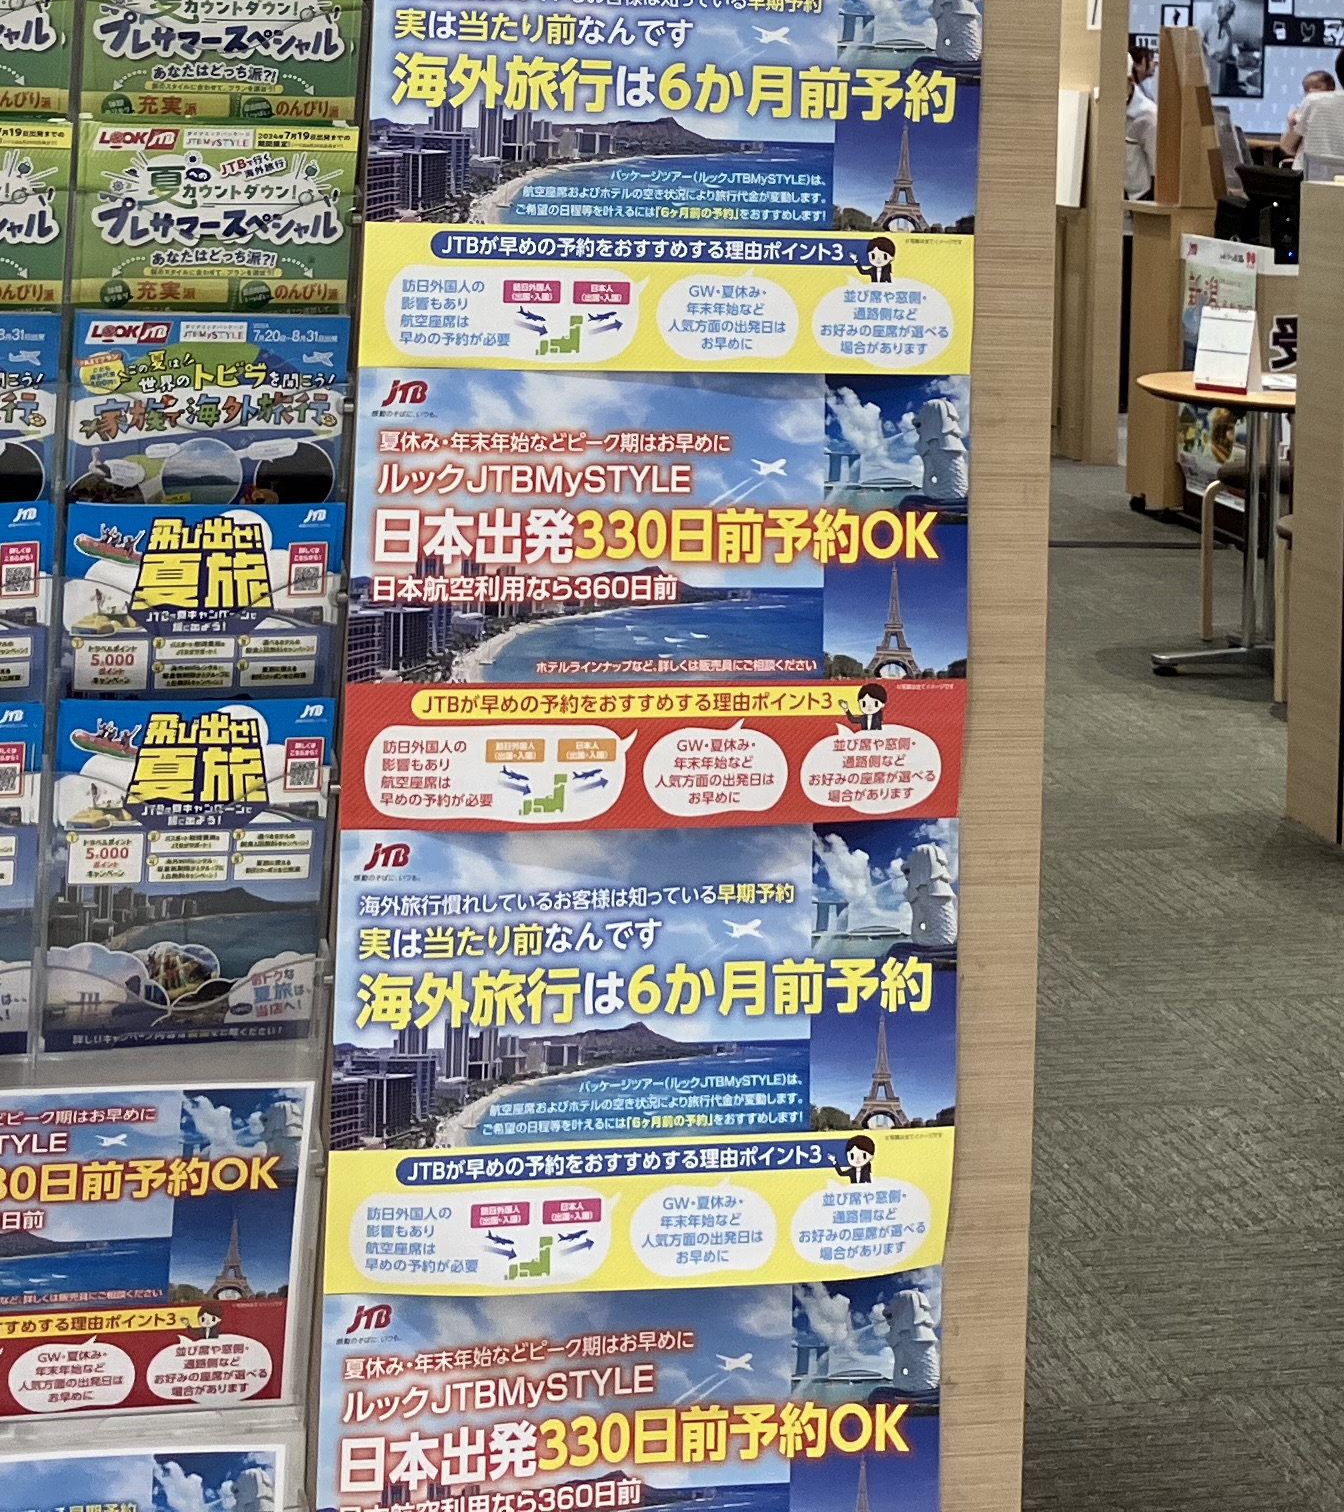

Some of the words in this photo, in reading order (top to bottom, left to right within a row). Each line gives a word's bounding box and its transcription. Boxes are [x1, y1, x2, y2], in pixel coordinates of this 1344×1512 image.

[99, 3, 340, 62] プレサマースペシャル
[394, 9, 694, 49] 実は当たり前なんです
[390, 50, 957, 125] 海外旅行は6か月前予約
[99, 197, 338, 242] プレサマースペシャル
[440, 235, 844, 262] JTBが早めの予約をおすすめする理由ポイント3
[401, 279, 485, 295] 訪日外国人の
[685, 302, 765, 317] 年末年始など
[819, 323, 950, 339] お好みの座席が選べる
[372, 507, 940, 566] 日本出発330日前予約OK
[132, 550, 274, 613] 夏旅
[371, 575, 678, 602] 日本航空利用なら360日前
[126, 747, 268, 805] 夏旅
[358, 918, 663, 961] 実は当たり前なんです
[356, 955, 934, 1031] 海外旅行は6か月前予約
[339, 1402, 911, 1493] 日本出発330日前予約OK
